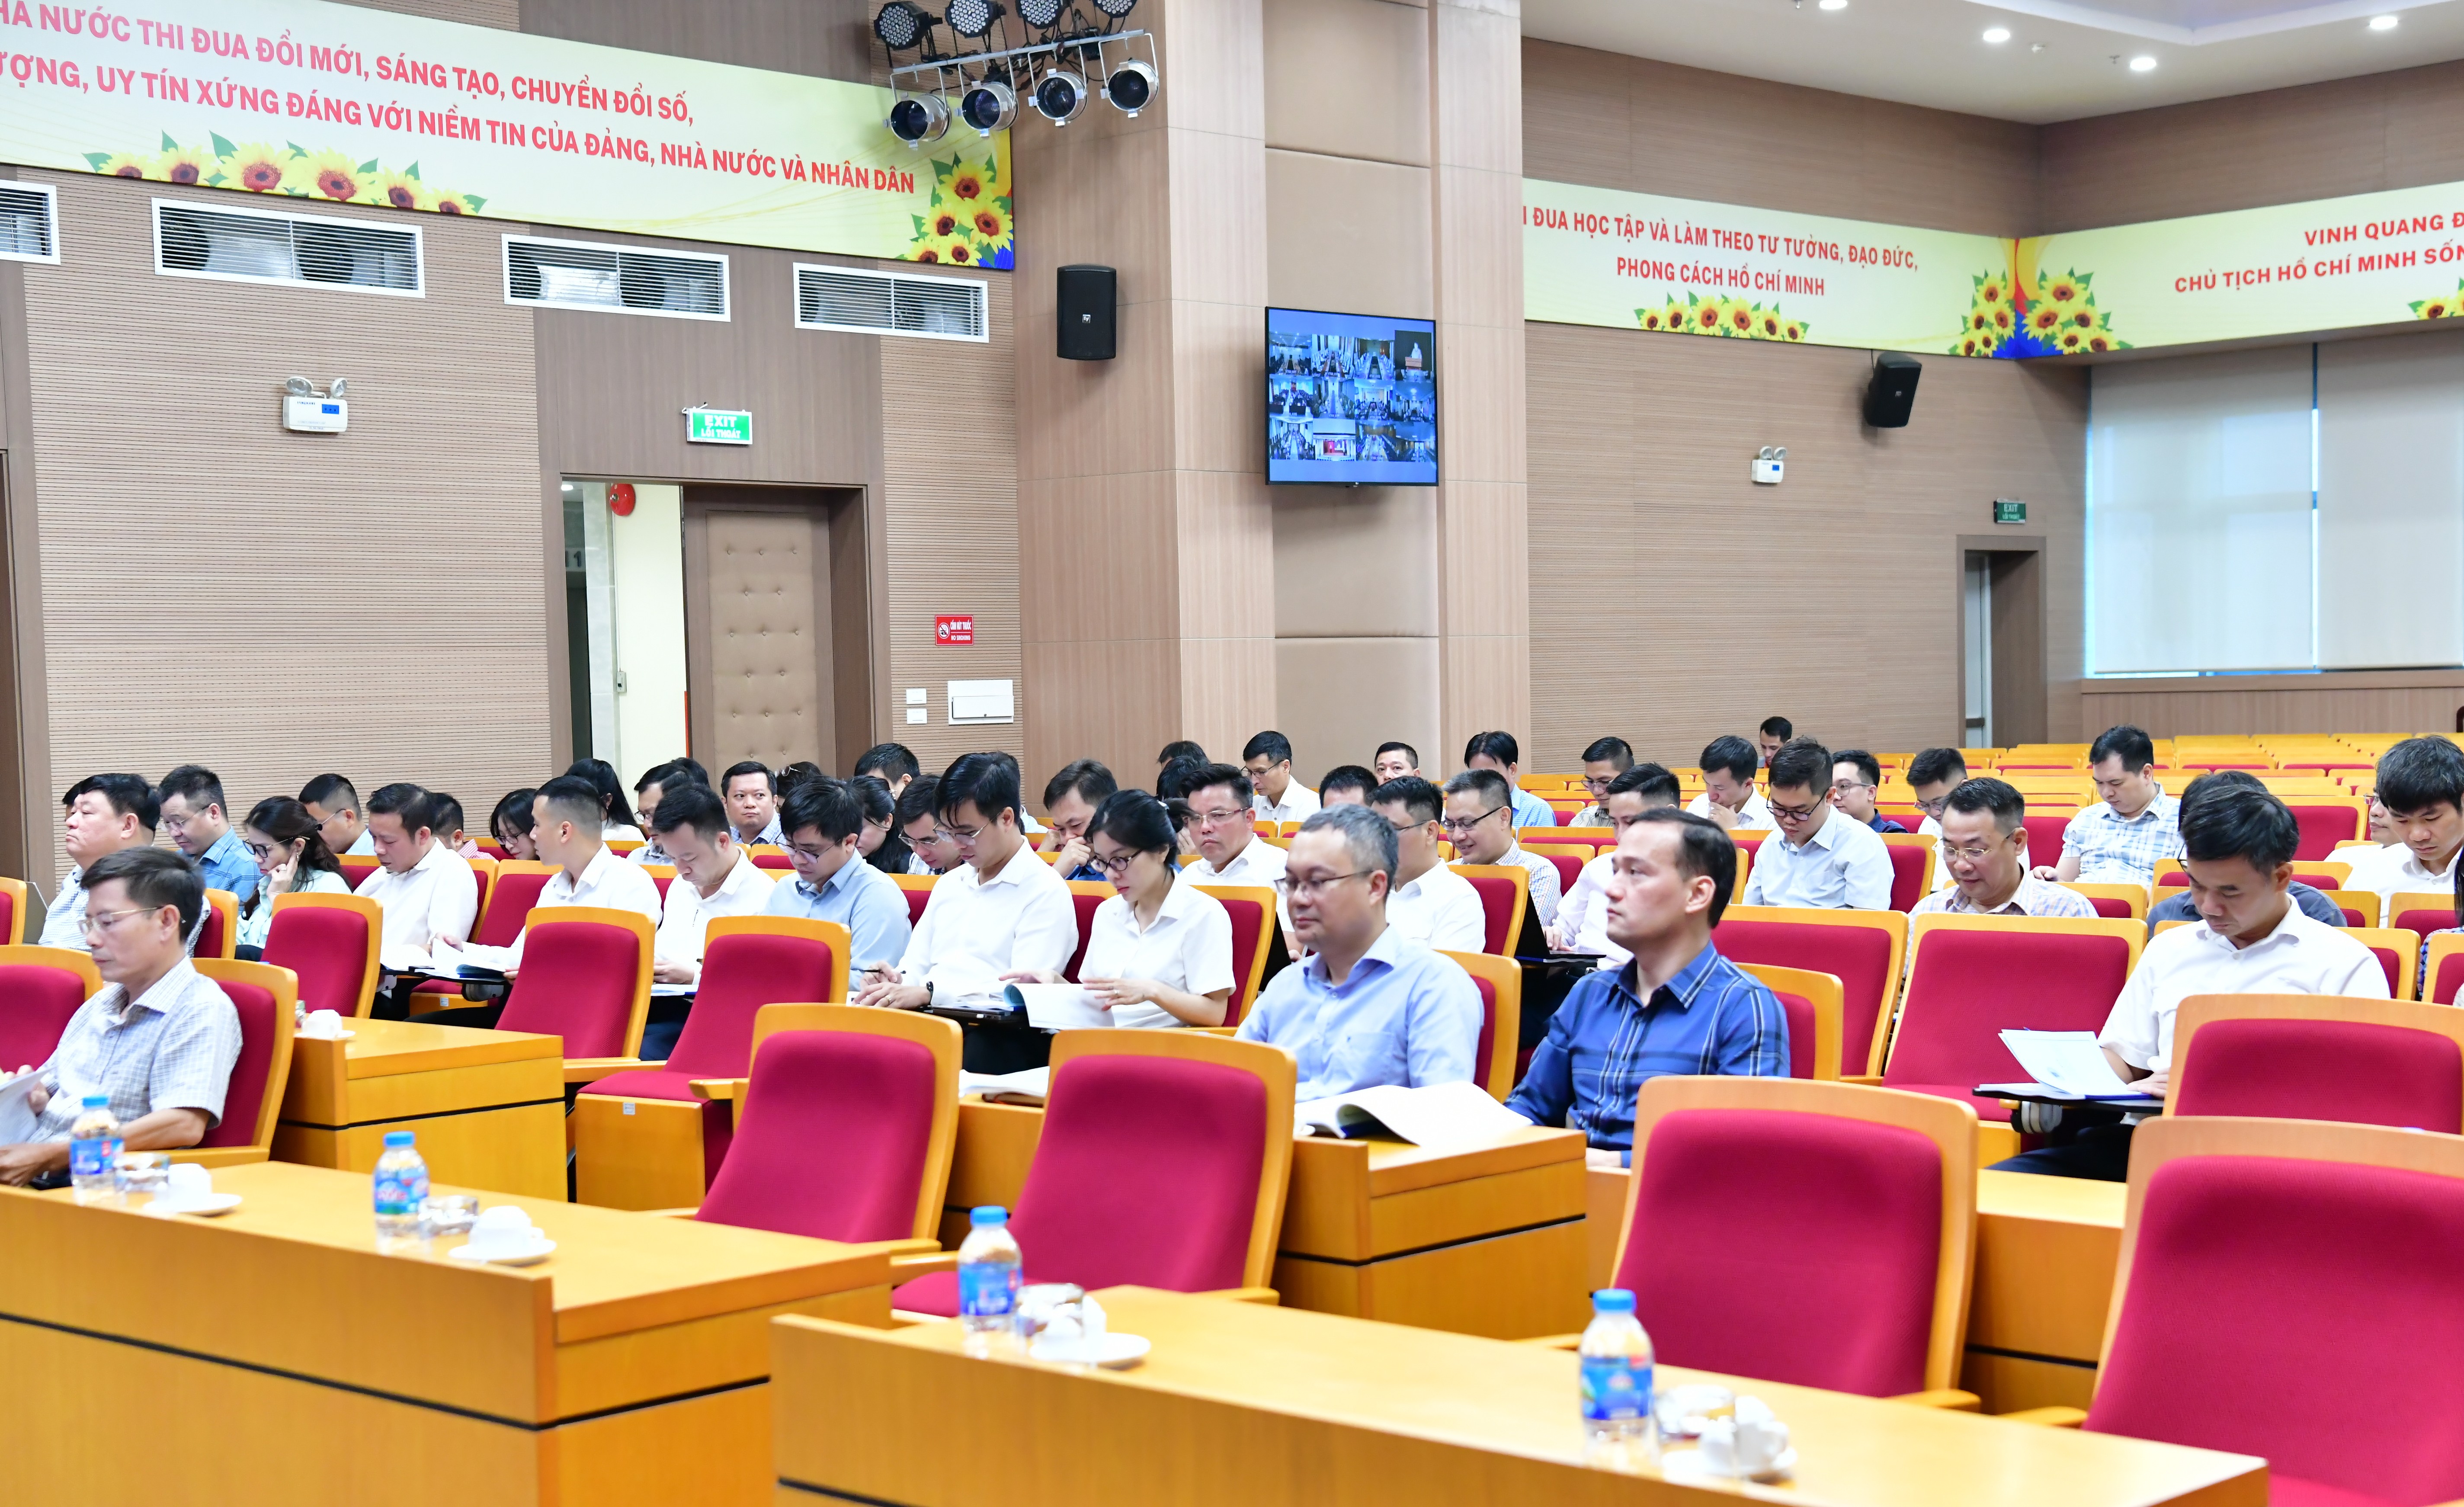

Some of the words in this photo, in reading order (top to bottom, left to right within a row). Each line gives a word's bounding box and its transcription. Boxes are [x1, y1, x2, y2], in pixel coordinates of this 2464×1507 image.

[39, 3, 130, 42] NƯỚC
[137, 19, 183, 50] THI
[191, 28, 250, 60] ĐUA
[256, 29, 303, 67] ĐỔI
[310, 43, 369, 82] MỚI,
[376, 52, 447, 89] SÁNG
[452, 67, 506, 101] TẠO,
[511, 74, 608, 111] CHUYỂN
[613, 82, 652, 117] ĐỔI
[658, 90, 693, 127] SỐ,
[96, 65, 135, 95] UY
[141, 68, 189, 102] TÍN
[196, 77, 279, 114] XỨNG
[286, 89, 362, 126] ĐÁNG
[367, 101, 412, 133] VỚI
[418, 104, 481, 141] NIỀM
[486, 119, 526, 147] TIN
[532, 120, 579, 154] CỦA
[584, 127, 655, 167] ĐẢNG,
[661, 141, 708, 170] NHÀ
[713, 148, 776, 178] NƯỚC
[780, 154, 807, 182] VÀ
[811, 160, 870, 189] NHÂN
[874, 166, 914, 194] DÂN
[1533, 207, 1568, 230] ĐUA
[1574, 212, 1609, 238] HỌC
[1614, 214, 1645, 242] TẬP
[1649, 218, 1669, 242] VÀ
[1674, 221, 1708, 247] LÀM
[1712, 229, 1754, 251] THEO
[1758, 234, 1780, 254] TƯ
[1784, 234, 1843, 264] TƯỞNG,
[1848, 245, 1878, 269] ĐẠO
[1882, 245, 1918, 272] ĐỨC,
[2304, 225, 2357, 246] VINH
[2365, 215, 2444, 240] QUANG
[1617, 257, 1675, 282] PHONG
[1680, 260, 1723, 286] CÁCH
[1728, 263, 1750, 289] HỒ
[1754, 269, 1781, 292] CHÍ
[1785, 275, 1824, 296] MINH
[2175, 269, 2217, 293] CHỦ
[2222, 267, 2271, 290] TỊCH
[2278, 257, 2308, 282] HỒ
[2314, 253, 2352, 277] CHÍ
[2358, 250, 2416, 273] MINH
[701, 426, 715, 437] LỐI
[716, 428, 741, 439] THOÁT
[704, 414, 737, 428] EXIT
[2004, 503, 2018, 513] EXIT
